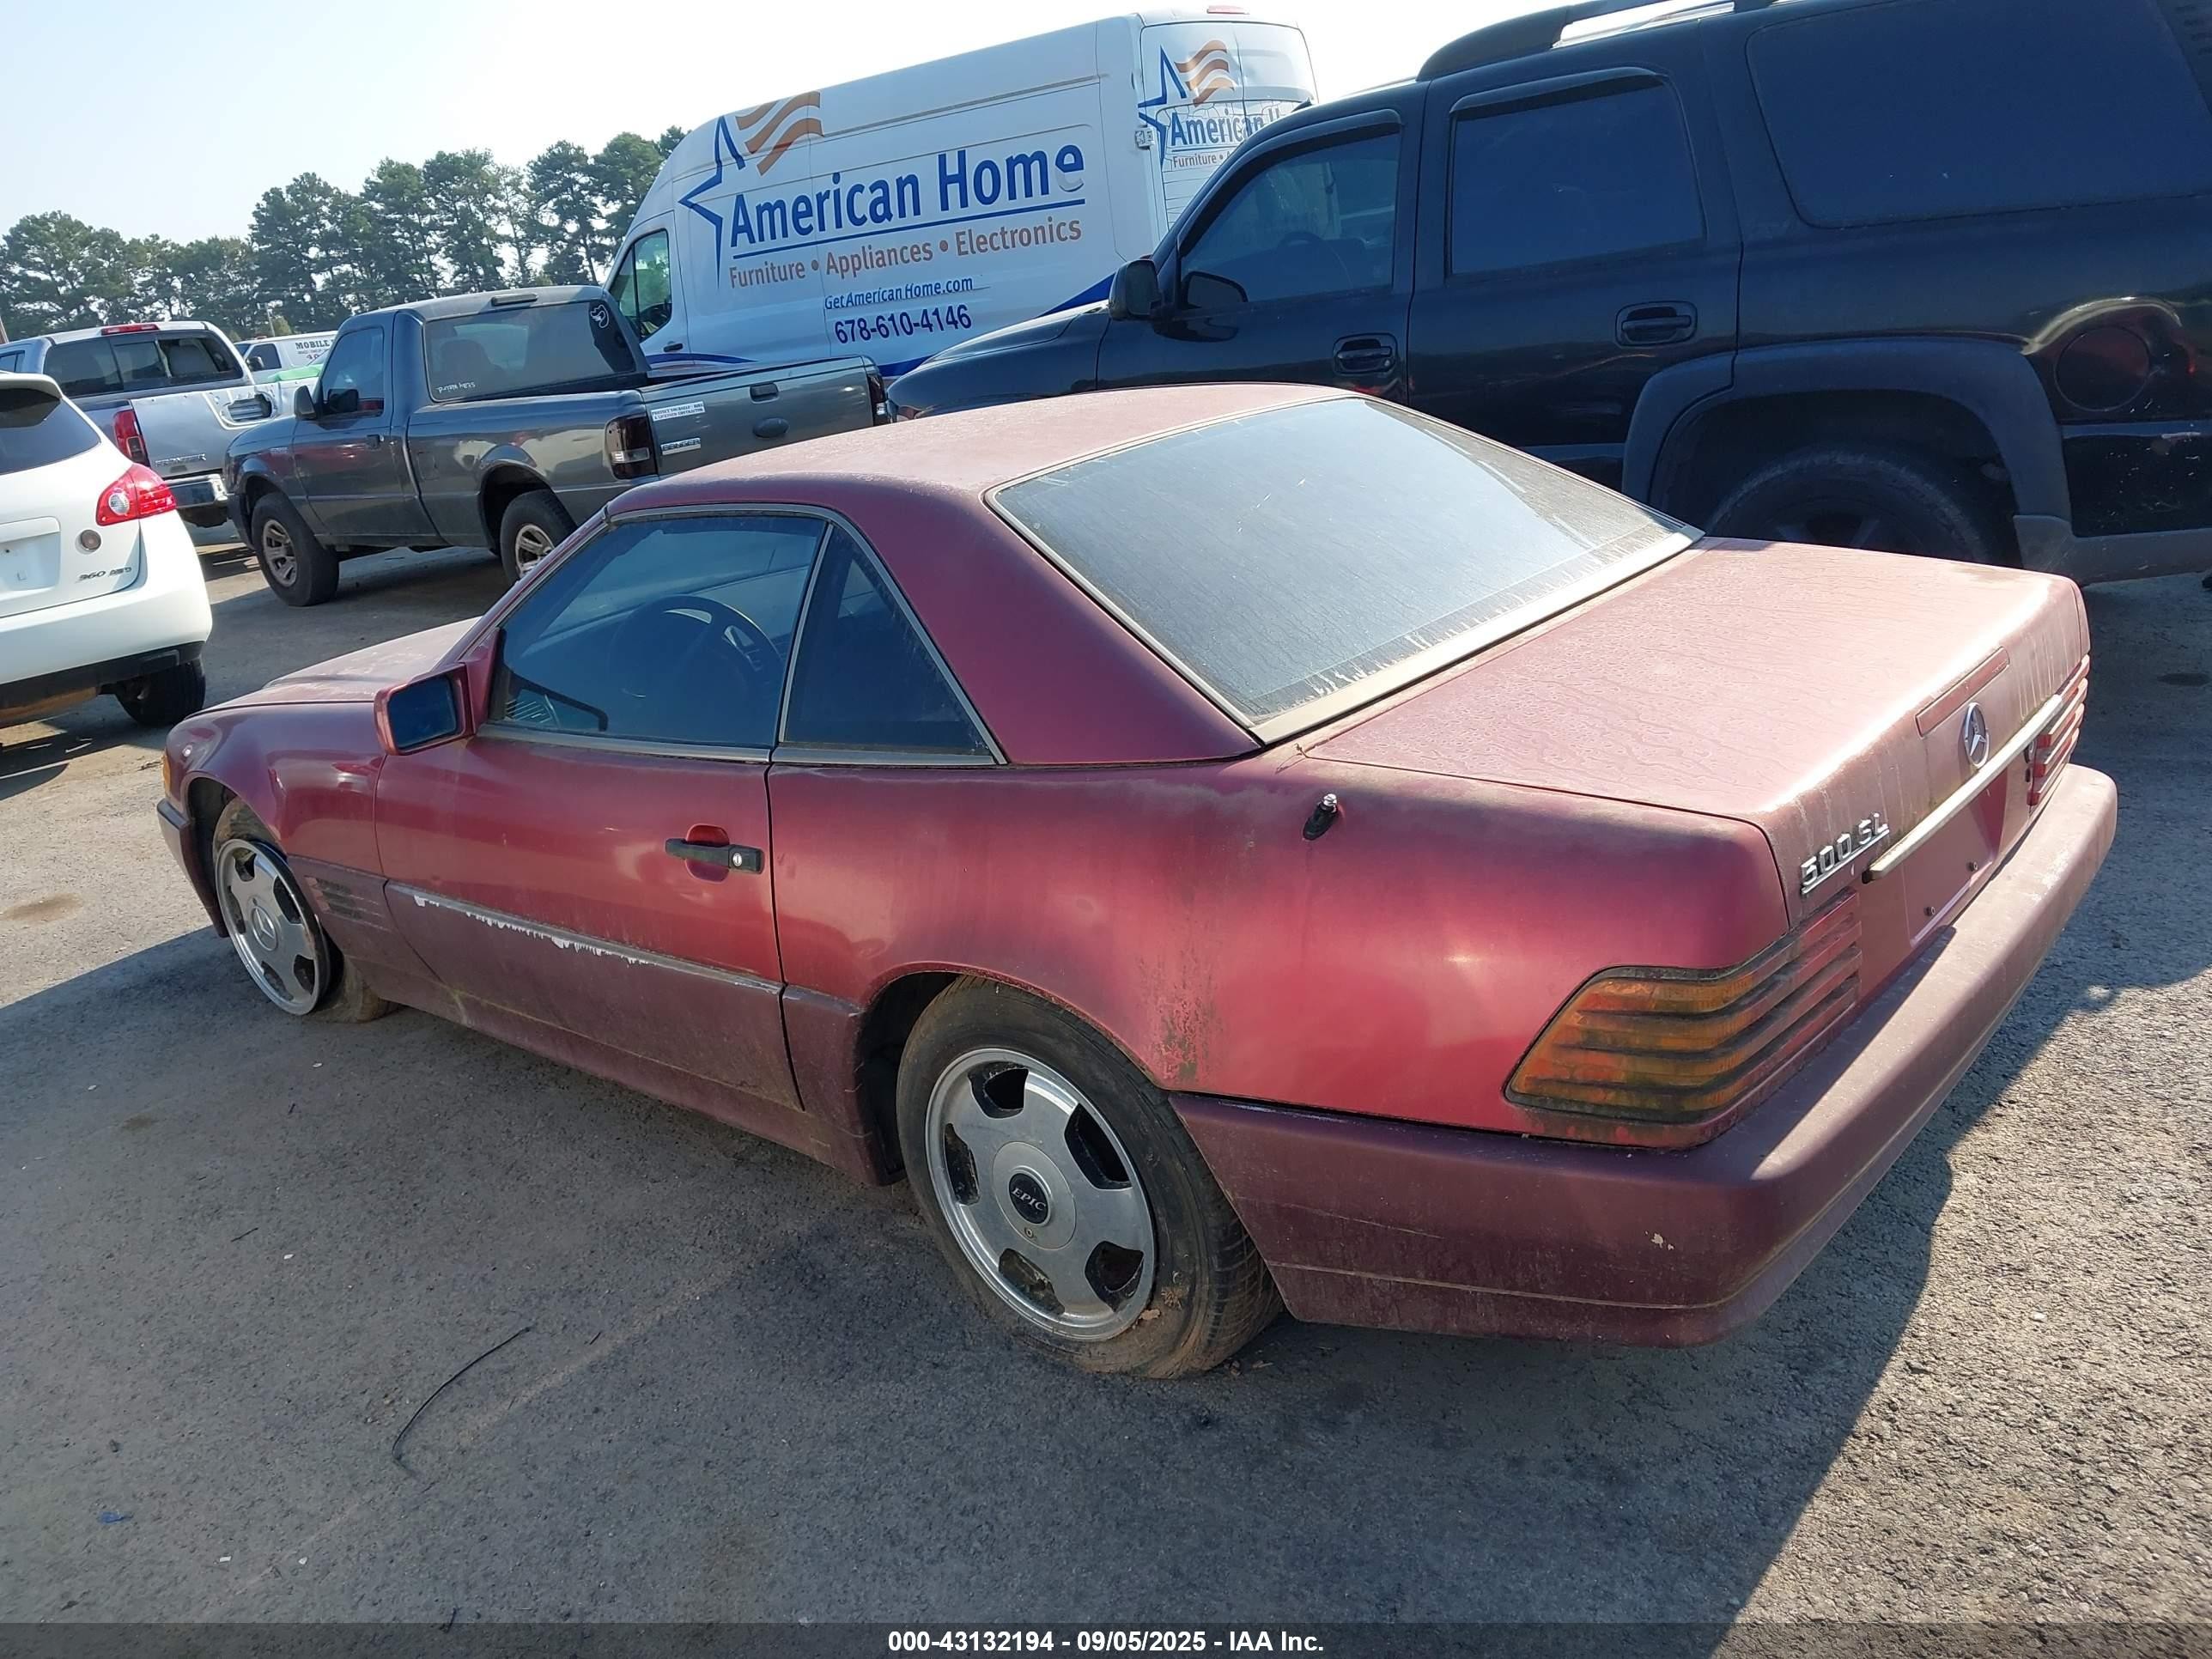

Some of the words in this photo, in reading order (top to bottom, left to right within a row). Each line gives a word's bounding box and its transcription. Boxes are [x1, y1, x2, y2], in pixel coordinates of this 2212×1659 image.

[1171, 108, 1264, 146] American
[1173, 153, 1217, 167] Furniture
[730, 171, 921, 247] American
[938, 149, 1085, 212] Home
[730, 259, 806, 289] Furniture
[826, 242, 933, 279] Appliances
[955, 216, 1082, 256] Electronics
[835, 304, 972, 344] 678-610-4146
[295, 339, 330, 349] MOBILE
[1800, 833, 1852, 886] 500
[1857, 812, 1888, 845] SL
[1011, 1188, 1047, 1211] EPIC
